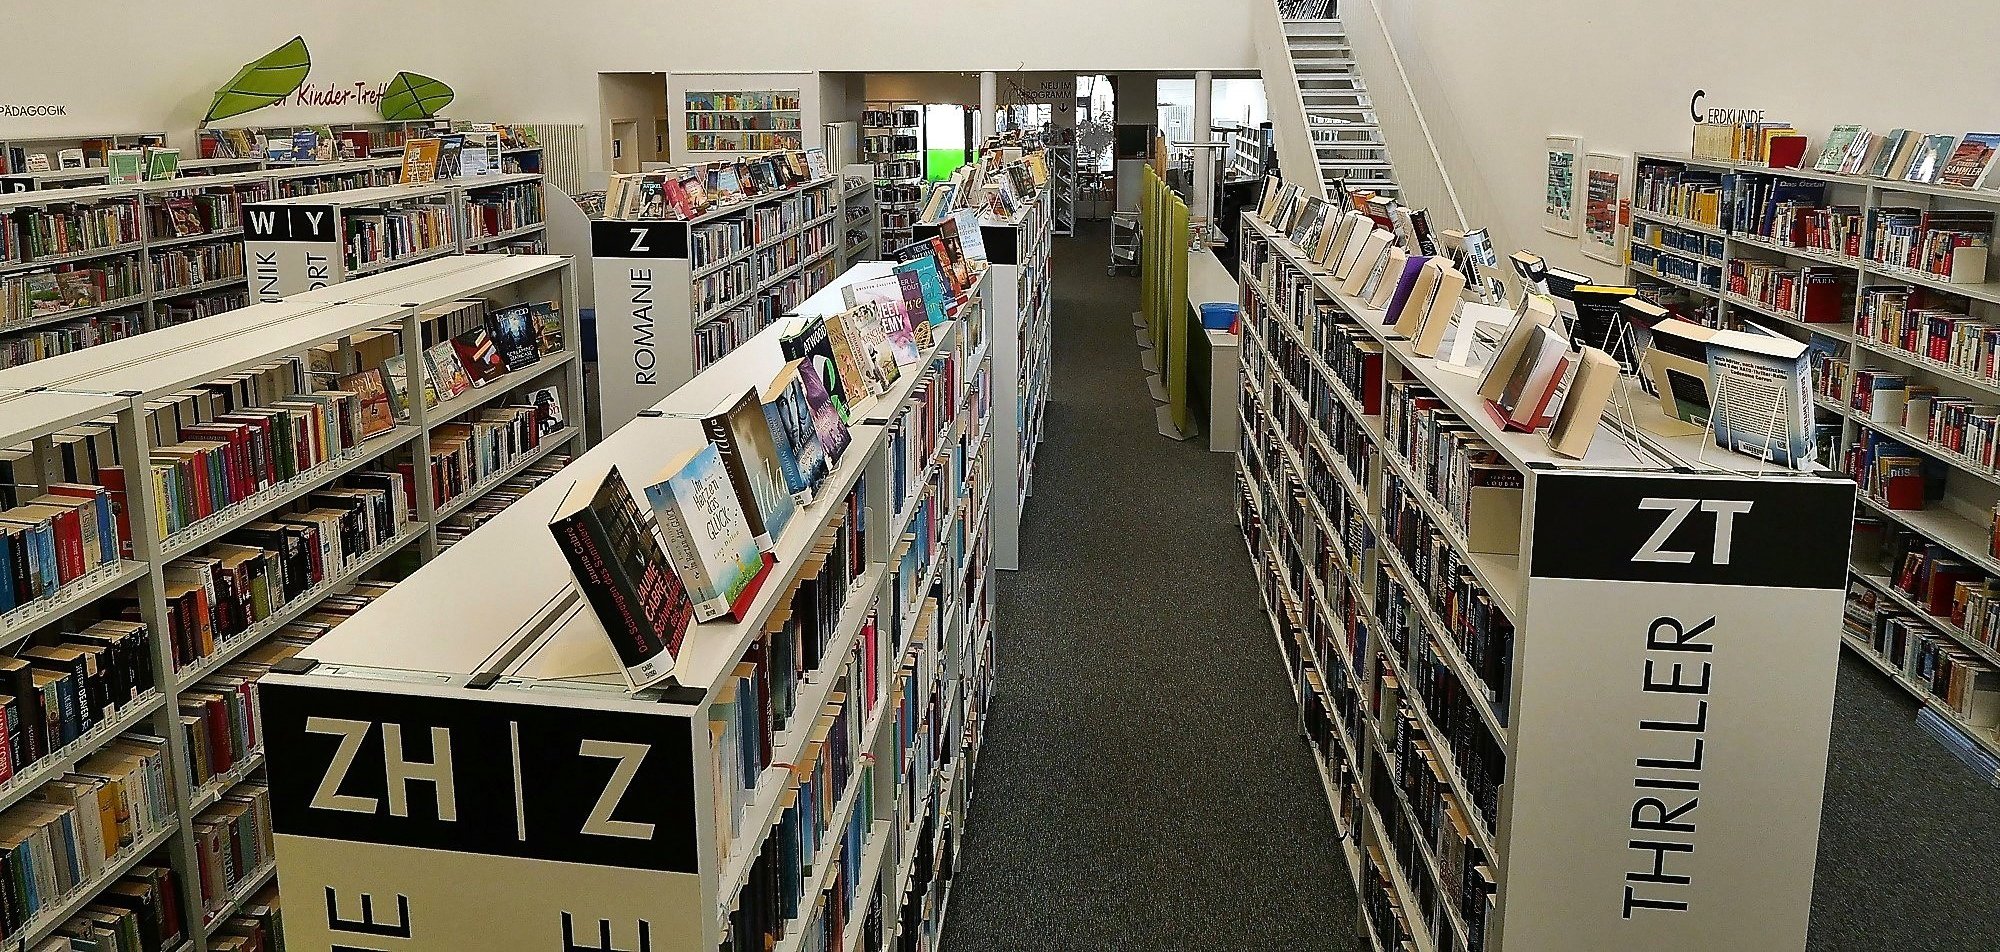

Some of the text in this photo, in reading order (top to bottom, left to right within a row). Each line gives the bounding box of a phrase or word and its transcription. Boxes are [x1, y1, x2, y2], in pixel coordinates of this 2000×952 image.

[1041, 82, 1072, 90] NEU IM
[1690, 89, 1706, 123] C
[1945, 165, 1982, 176] SAMMLER
[250, 210, 324, 236] W Y
[629, 228, 651, 252] Z
[255, 250, 283, 303] NIK
[901, 283, 919, 292] ROUT
[878, 301, 900, 319] EET
[630, 268, 656, 385] ROMANE
[804, 324, 827, 356] ATWOOD
[710, 426, 732, 455] Ida
[693, 479, 719, 511] Herzen
[706, 496, 720, 515] das
[754, 457, 787, 524] Ida
[1631, 497, 1755, 566] ZT
[565, 526, 601, 585] Jaume Cabré
[600, 567, 613, 586] des
[638, 559, 660, 606] JAUME
[609, 584, 638, 635] Schweigen
[635, 635, 648, 653] Das
[304, 715, 656, 841] ZH Z
[1621, 614, 1717, 919] THRILLER
